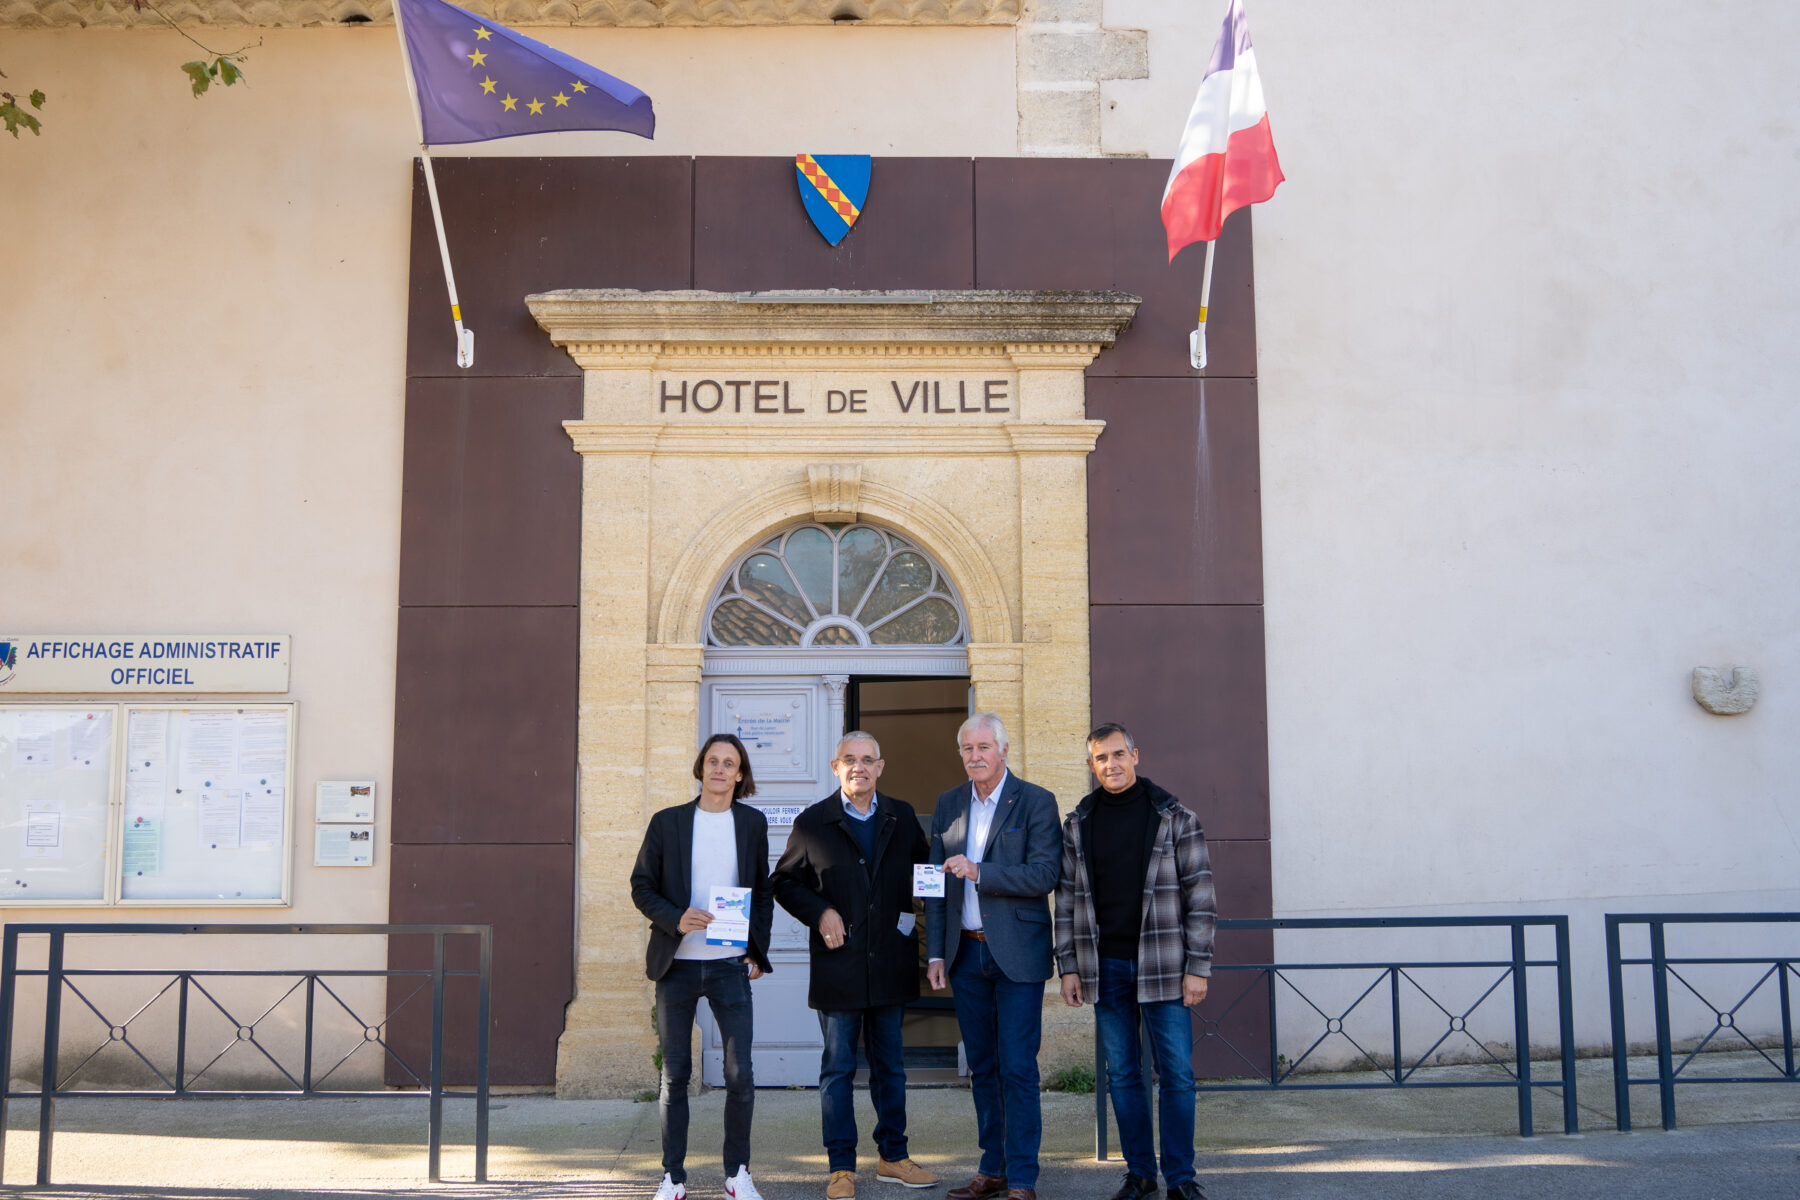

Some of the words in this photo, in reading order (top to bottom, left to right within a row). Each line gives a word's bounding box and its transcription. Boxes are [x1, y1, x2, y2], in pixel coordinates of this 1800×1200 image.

[660, 380, 805, 414] HOTEL
[827, 389, 868, 414] DE
[891, 380, 1010, 414] VILLE
[27, 641, 134, 659] AFFICHAGE
[138, 642, 281, 659] ADMINISTRATIF
[111, 668, 194, 685] OFFICIEL
